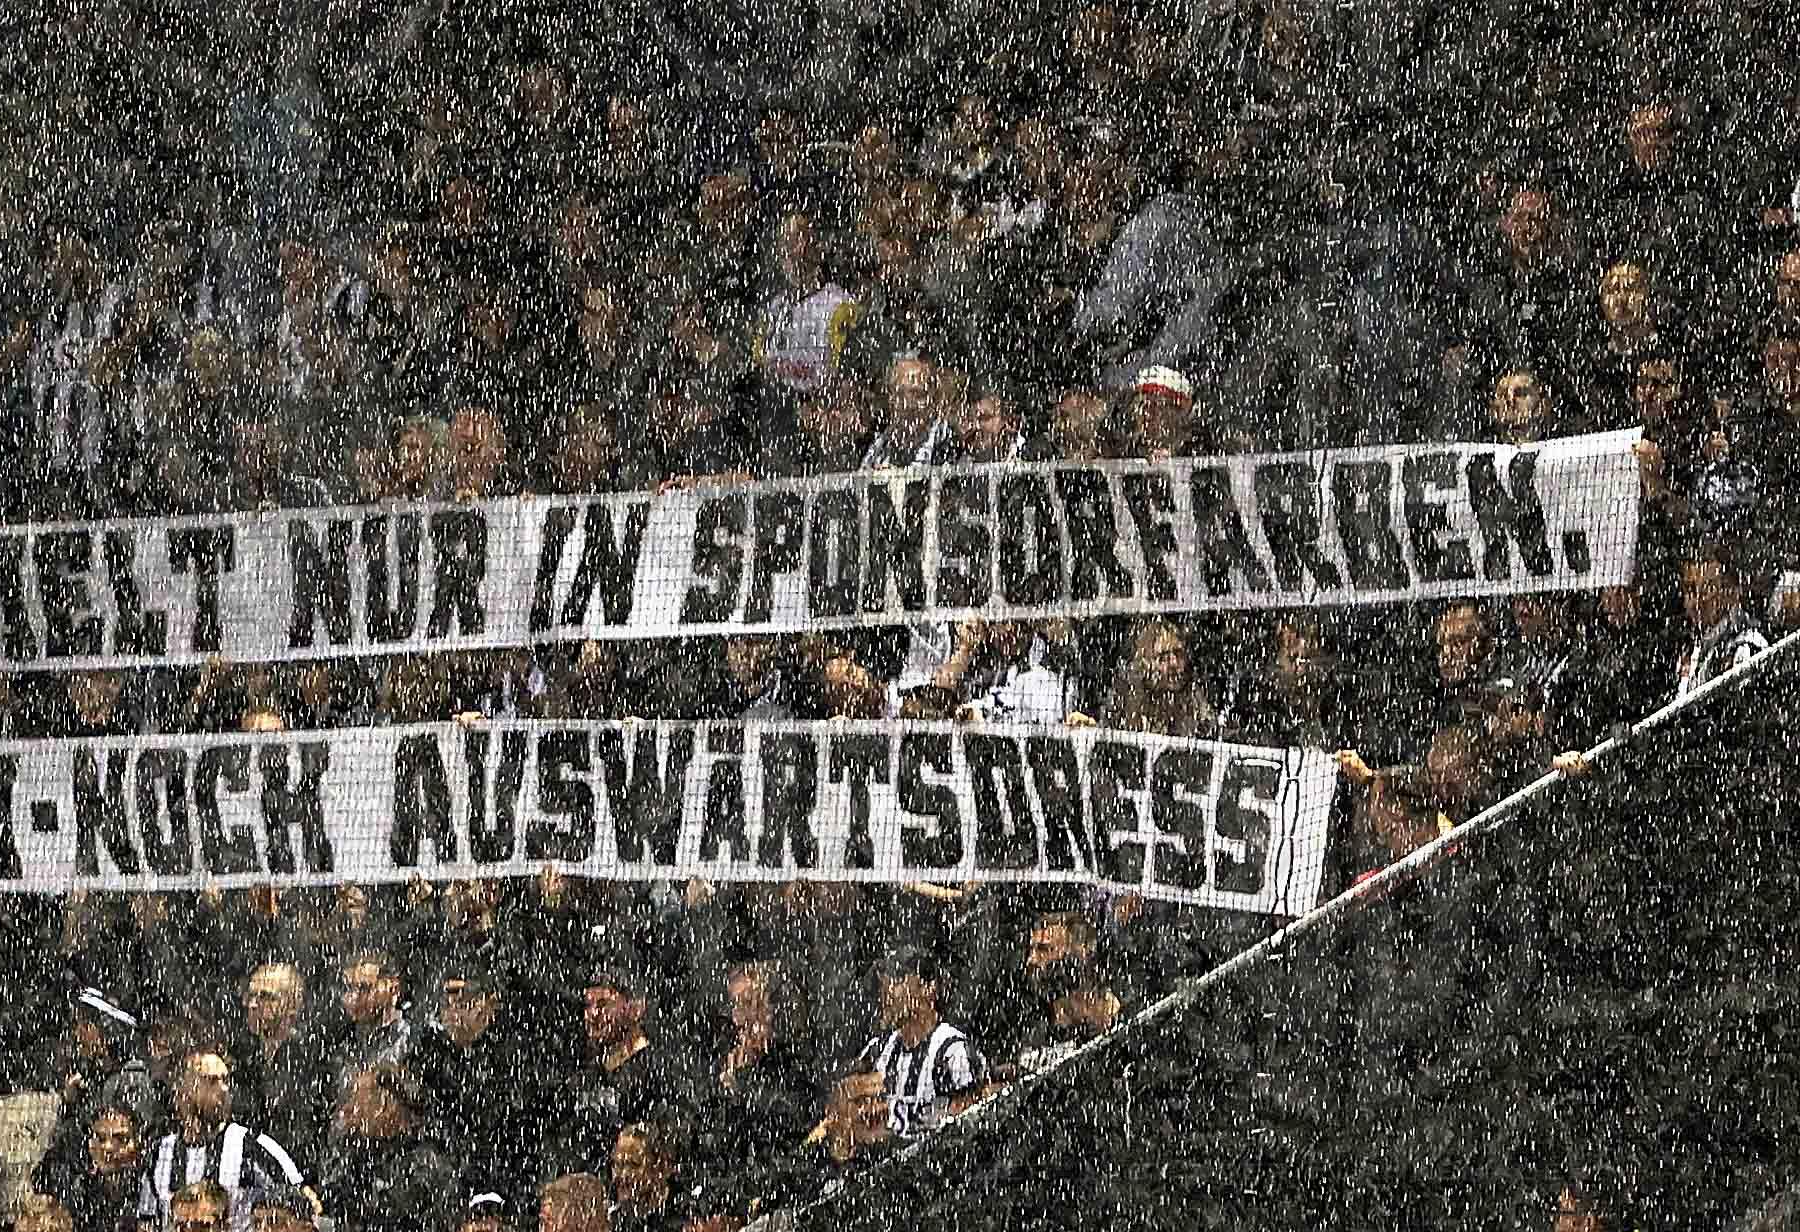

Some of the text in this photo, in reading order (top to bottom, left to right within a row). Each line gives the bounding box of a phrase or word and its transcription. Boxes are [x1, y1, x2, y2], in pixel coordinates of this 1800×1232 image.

[288, 508, 488, 648] NUR
[530, 500, 650, 629] IN
[679, 449, 1591, 625] SPONSORFARBEN.
[391, 726, 1279, 895] AUSWÄRTSDRESS
